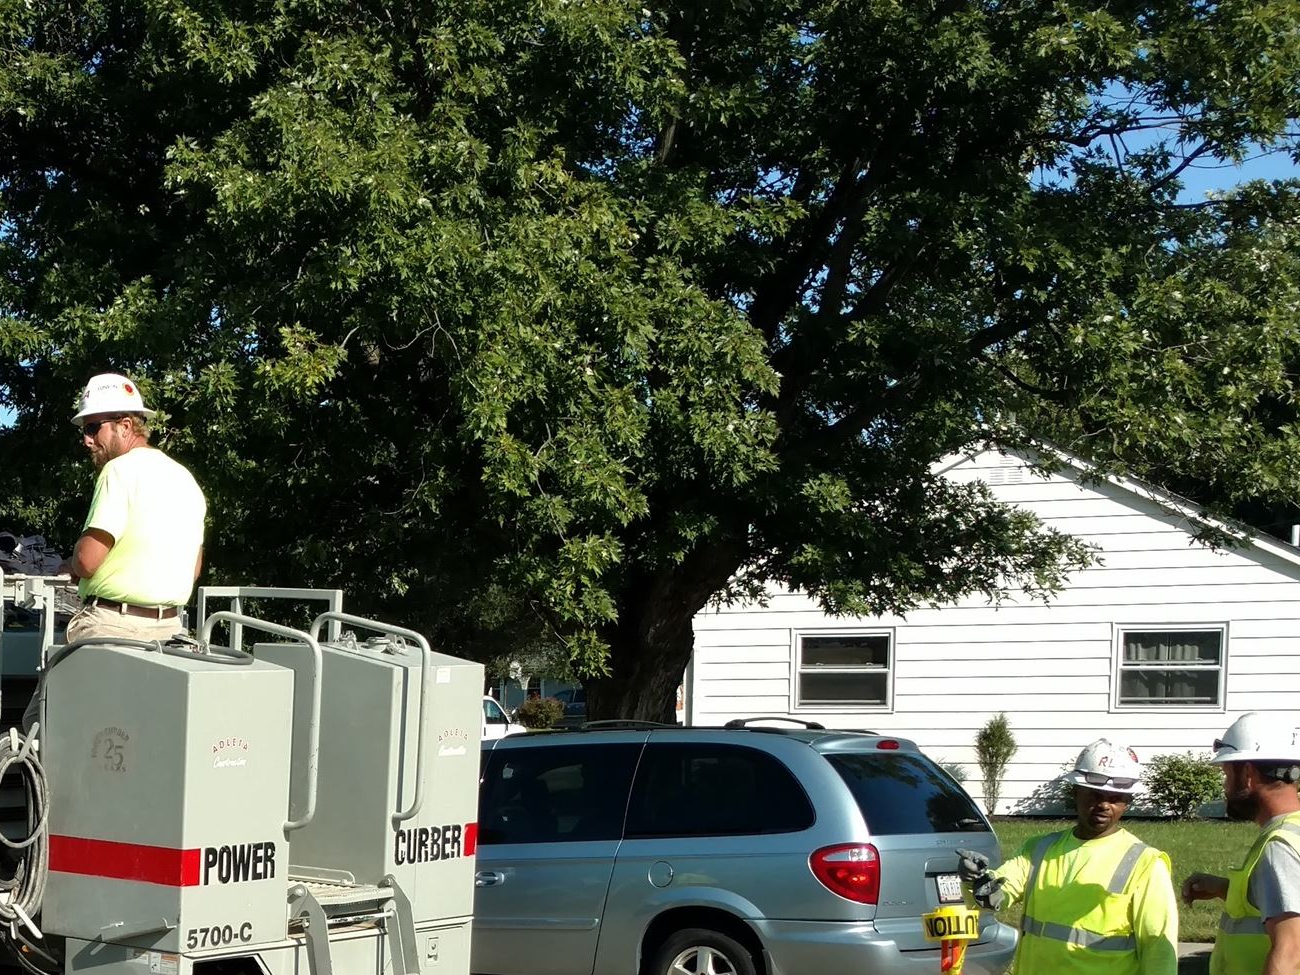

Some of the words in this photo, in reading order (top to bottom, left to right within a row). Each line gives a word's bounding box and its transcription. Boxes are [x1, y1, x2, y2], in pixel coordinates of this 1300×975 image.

[103, 739, 124, 766] 25
[394, 825, 462, 866] CURBER
[203, 841, 276, 886] POWER
[187, 922, 253, 949] 5700-C
